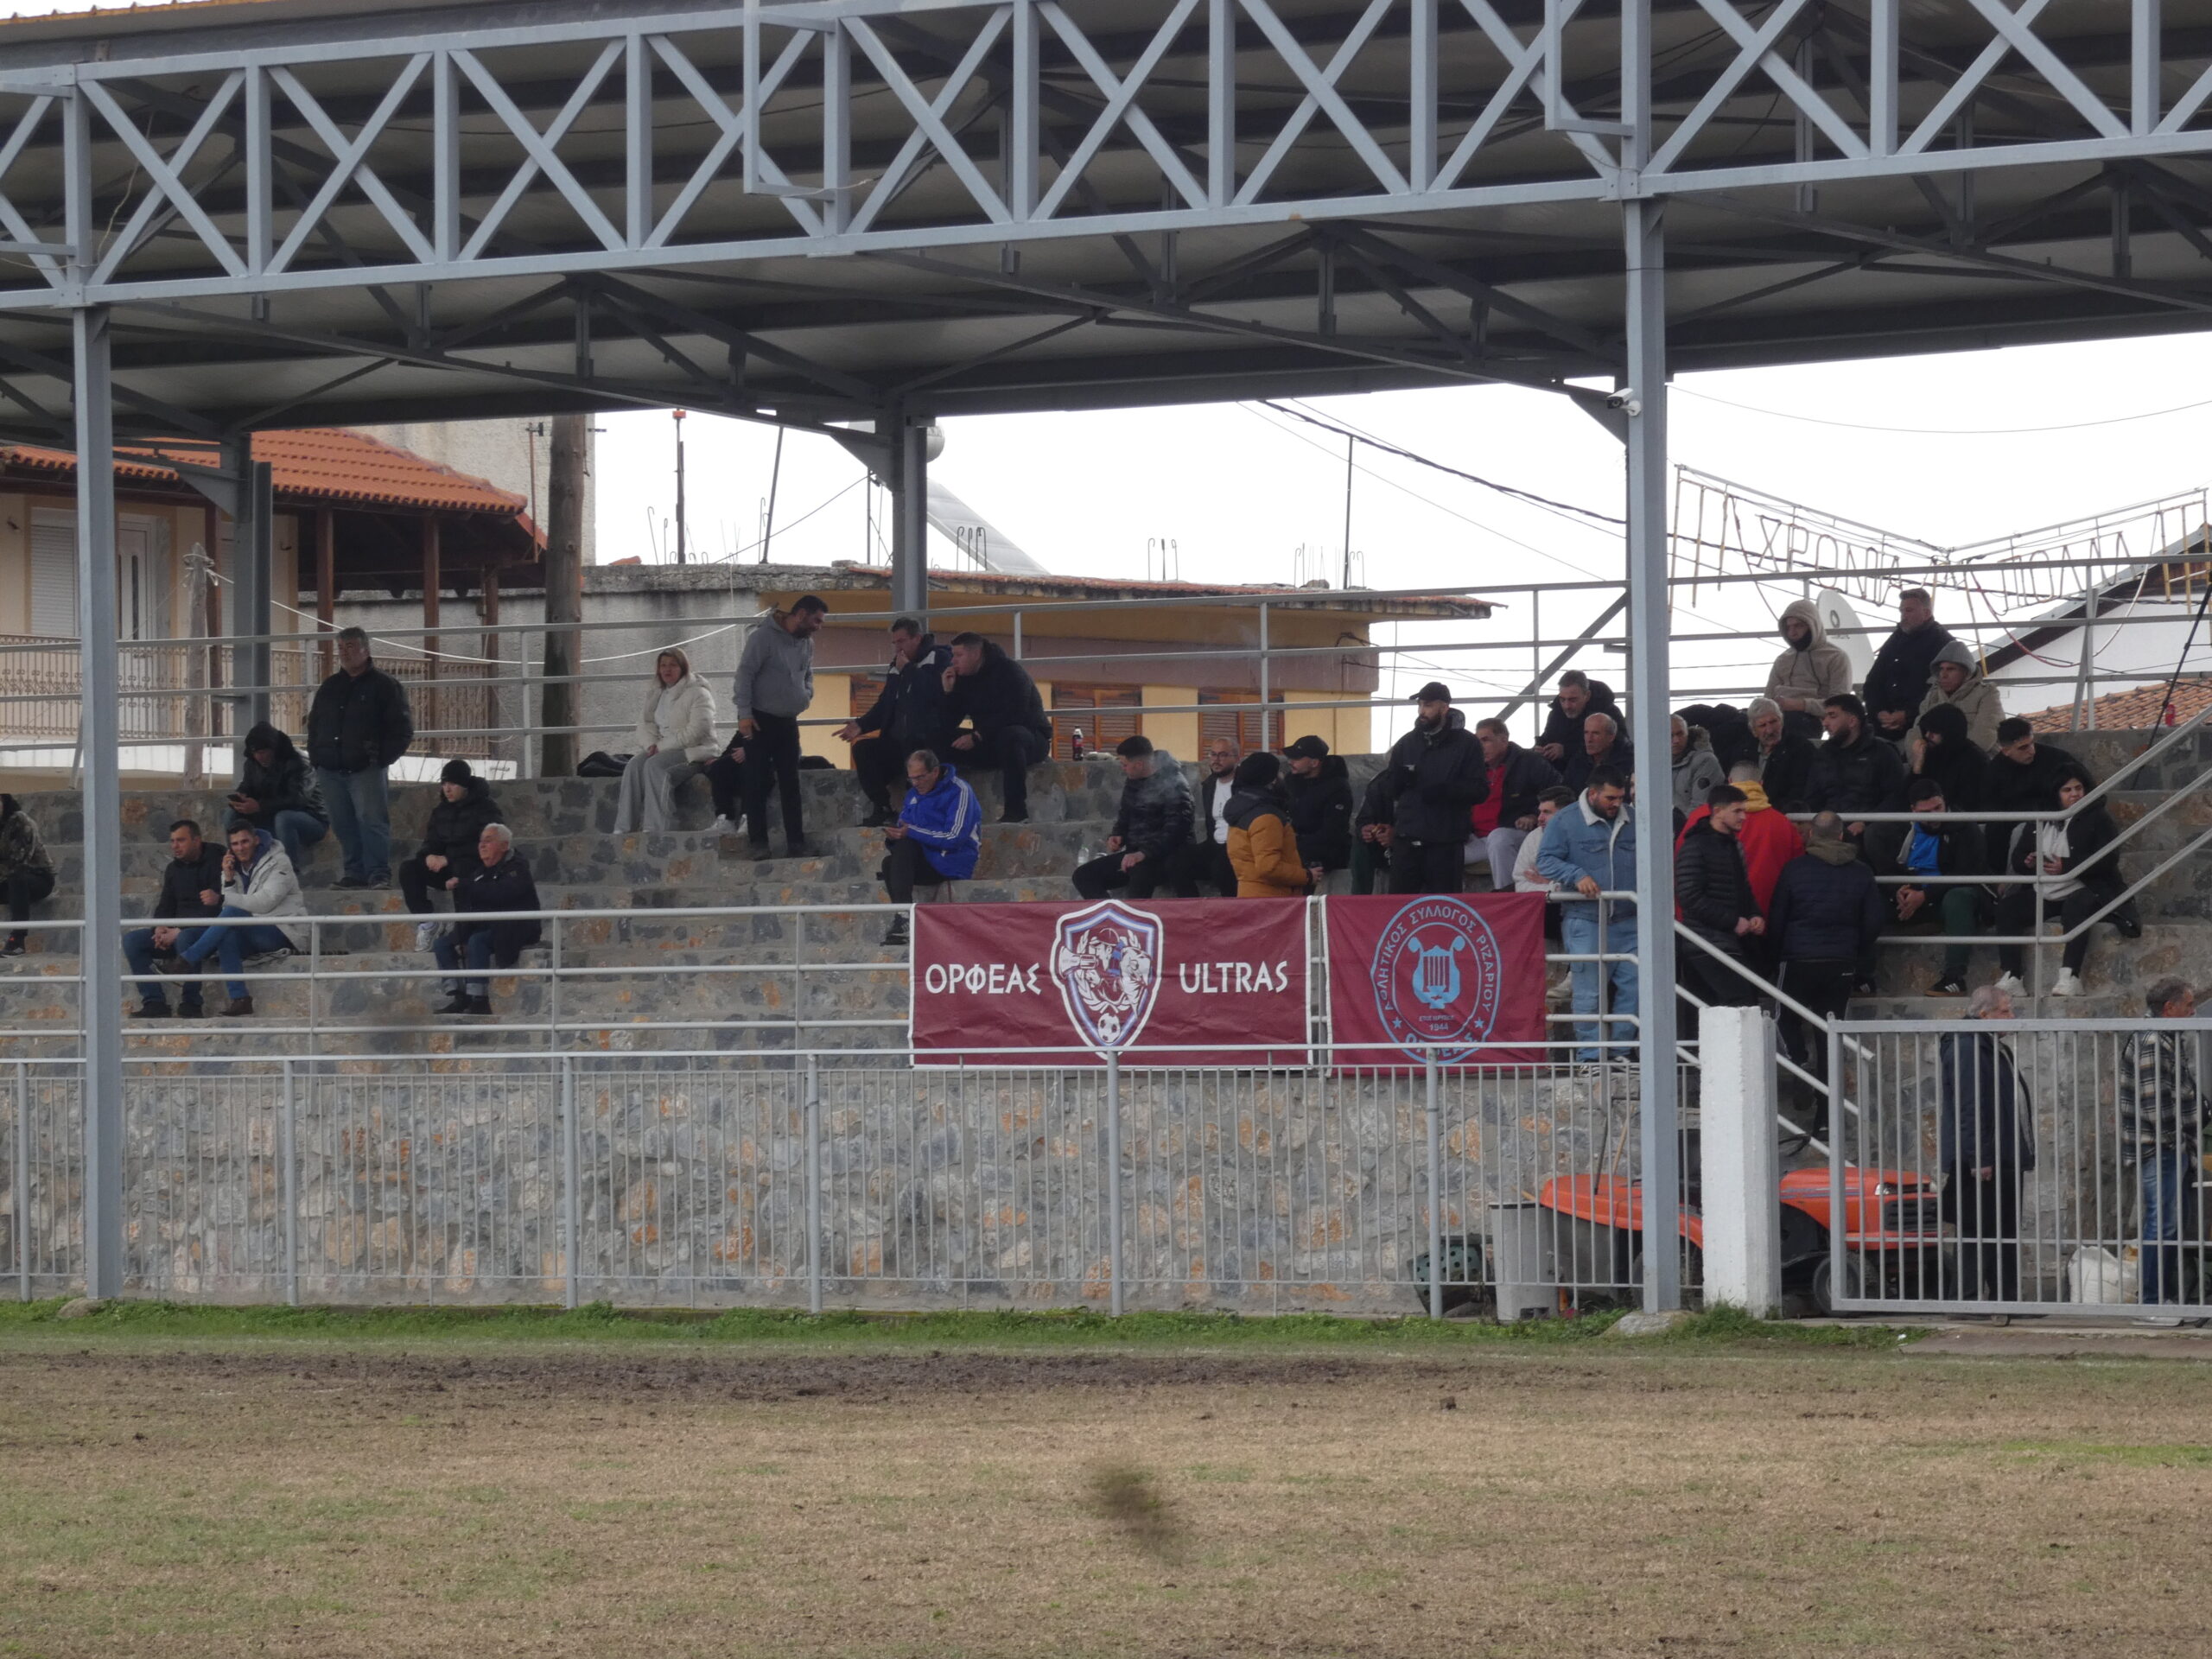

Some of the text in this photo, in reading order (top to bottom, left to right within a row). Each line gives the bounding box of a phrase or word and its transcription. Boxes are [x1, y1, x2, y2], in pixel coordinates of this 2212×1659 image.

[1409, 905, 1477, 933] ΣΥΛΛΟΓΟΣ
[1477, 934, 1495, 1012] ΡΙΖΑΡΙΟΥ
[925, 963, 1042, 995] ΟΡΦΕΑΣ
[1179, 960, 1288, 994] ULTRAS
